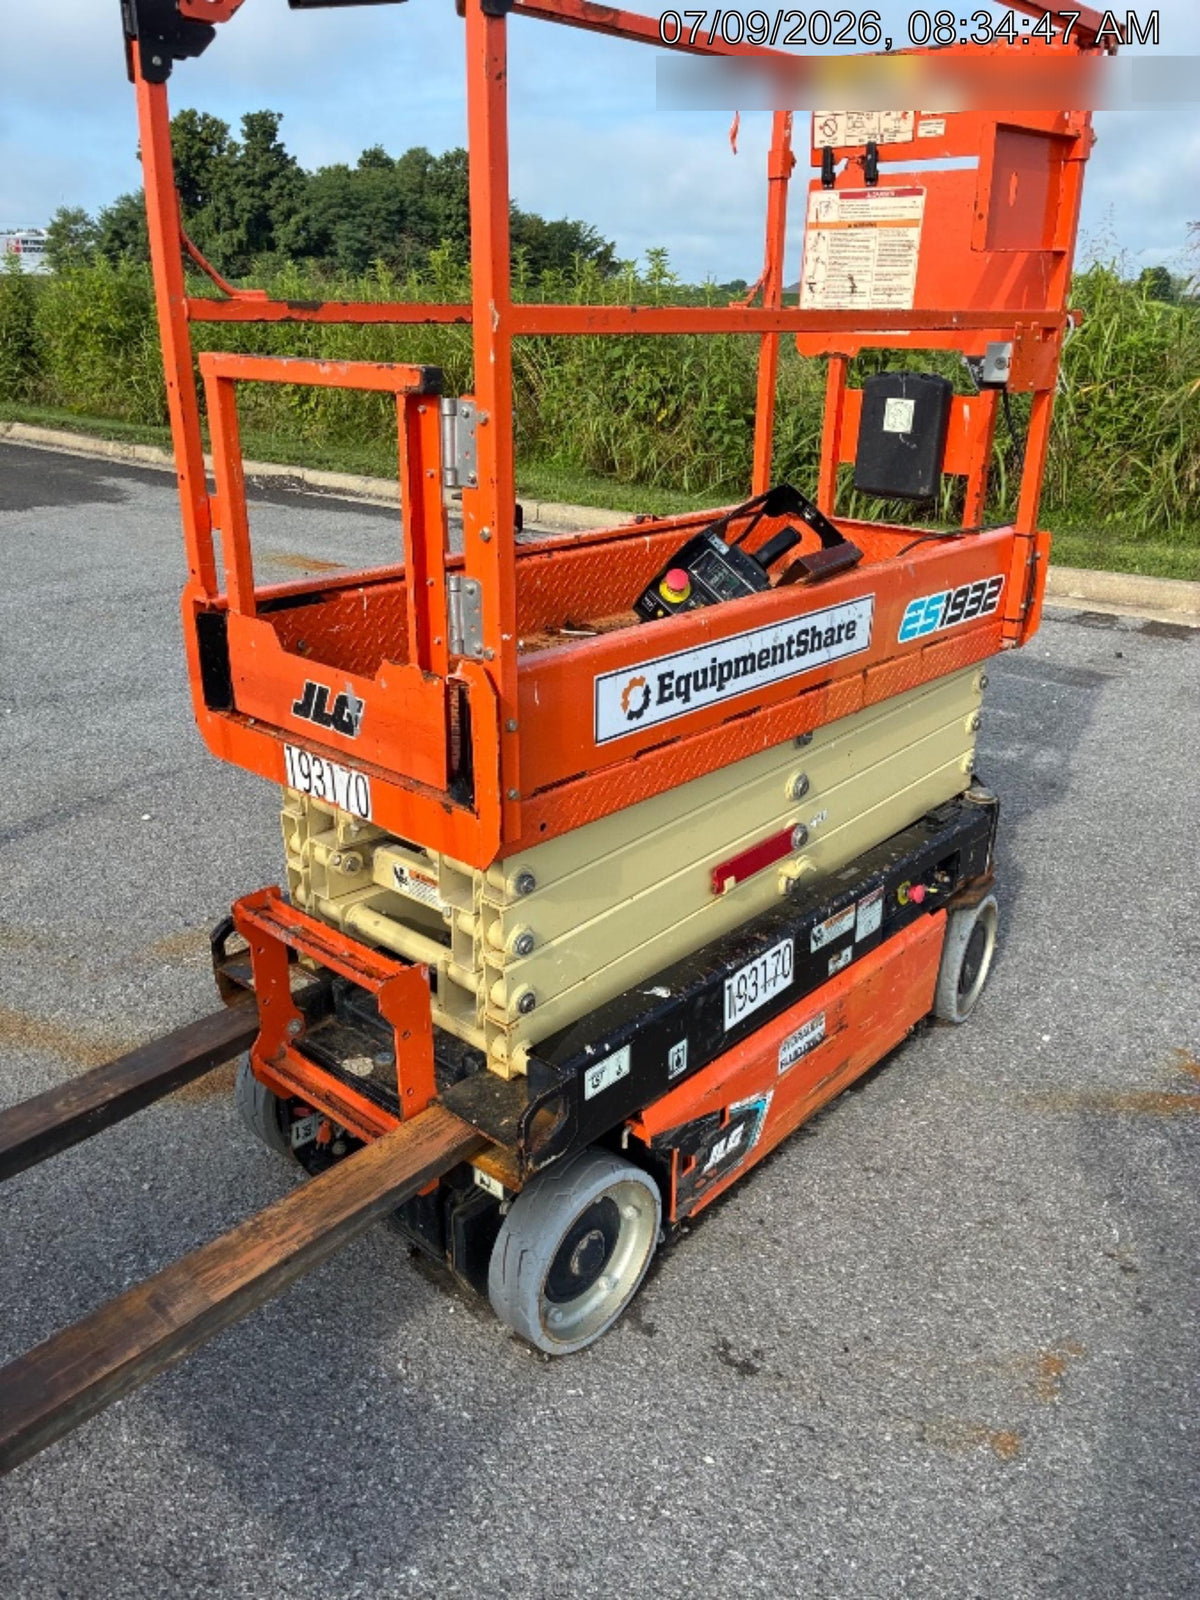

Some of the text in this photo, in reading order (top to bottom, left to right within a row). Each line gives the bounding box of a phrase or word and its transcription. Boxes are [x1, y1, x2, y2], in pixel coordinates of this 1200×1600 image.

[899, 576, 1003, 641] ES1932
[656, 619, 857, 705] EquipmentShare
[292, 681, 364, 737] JLG
[286, 745, 369, 819] 193170
[726, 943, 793, 1019] 193170
